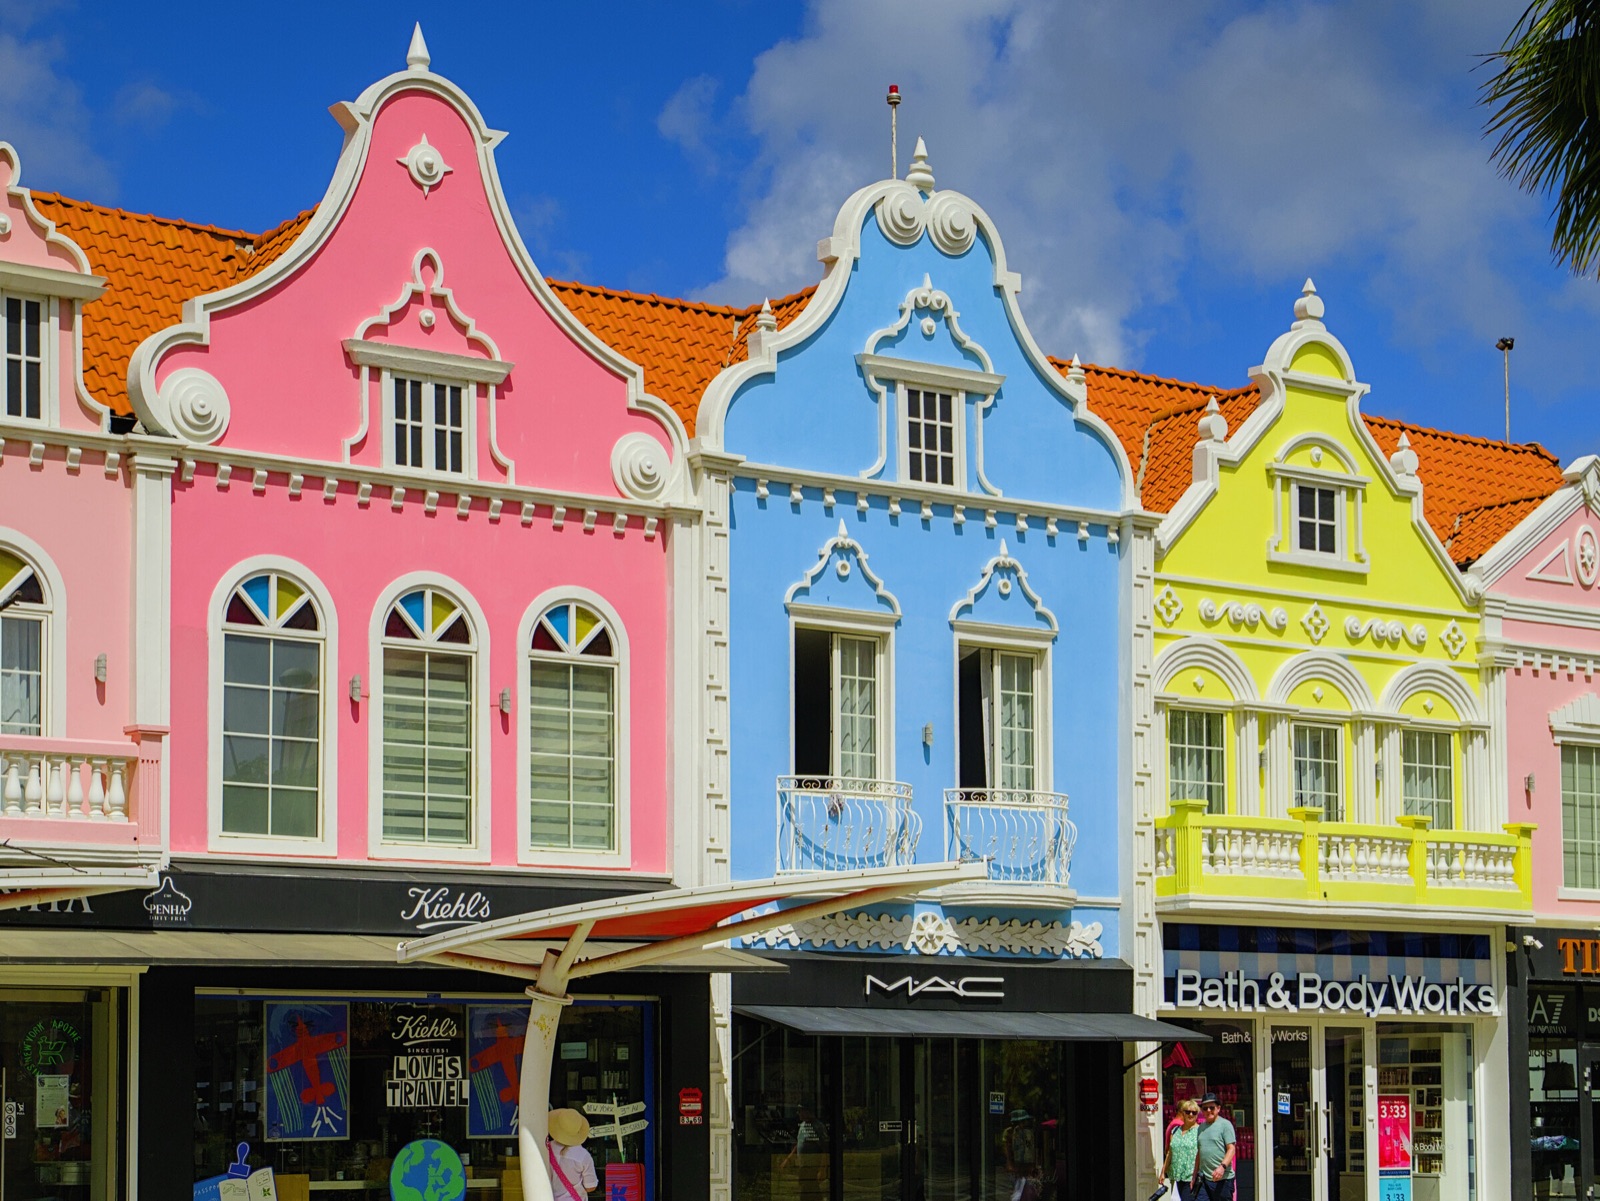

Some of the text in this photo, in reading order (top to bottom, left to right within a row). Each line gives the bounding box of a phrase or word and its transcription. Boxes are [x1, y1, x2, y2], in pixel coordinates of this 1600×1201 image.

[149, 904, 186, 915] PENHA
[401, 887, 490, 921] Kiehl's
[1177, 969, 1496, 1017] Bath & Body Works
[26, 1021, 45, 1042] YORK
[391, 1015, 457, 1040] Kiehl's
[1221, 1031, 1252, 1044] Bath &
[1277, 1030, 1308, 1042] Works
[394, 1055, 462, 1080] LOVES
[387, 1080, 470, 1107] TRAVEL
[991, 1093, 1003, 1102] OPEN
[1380, 1105, 1387, 1119] 3
[1390, 1105, 1406, 1119] $33
